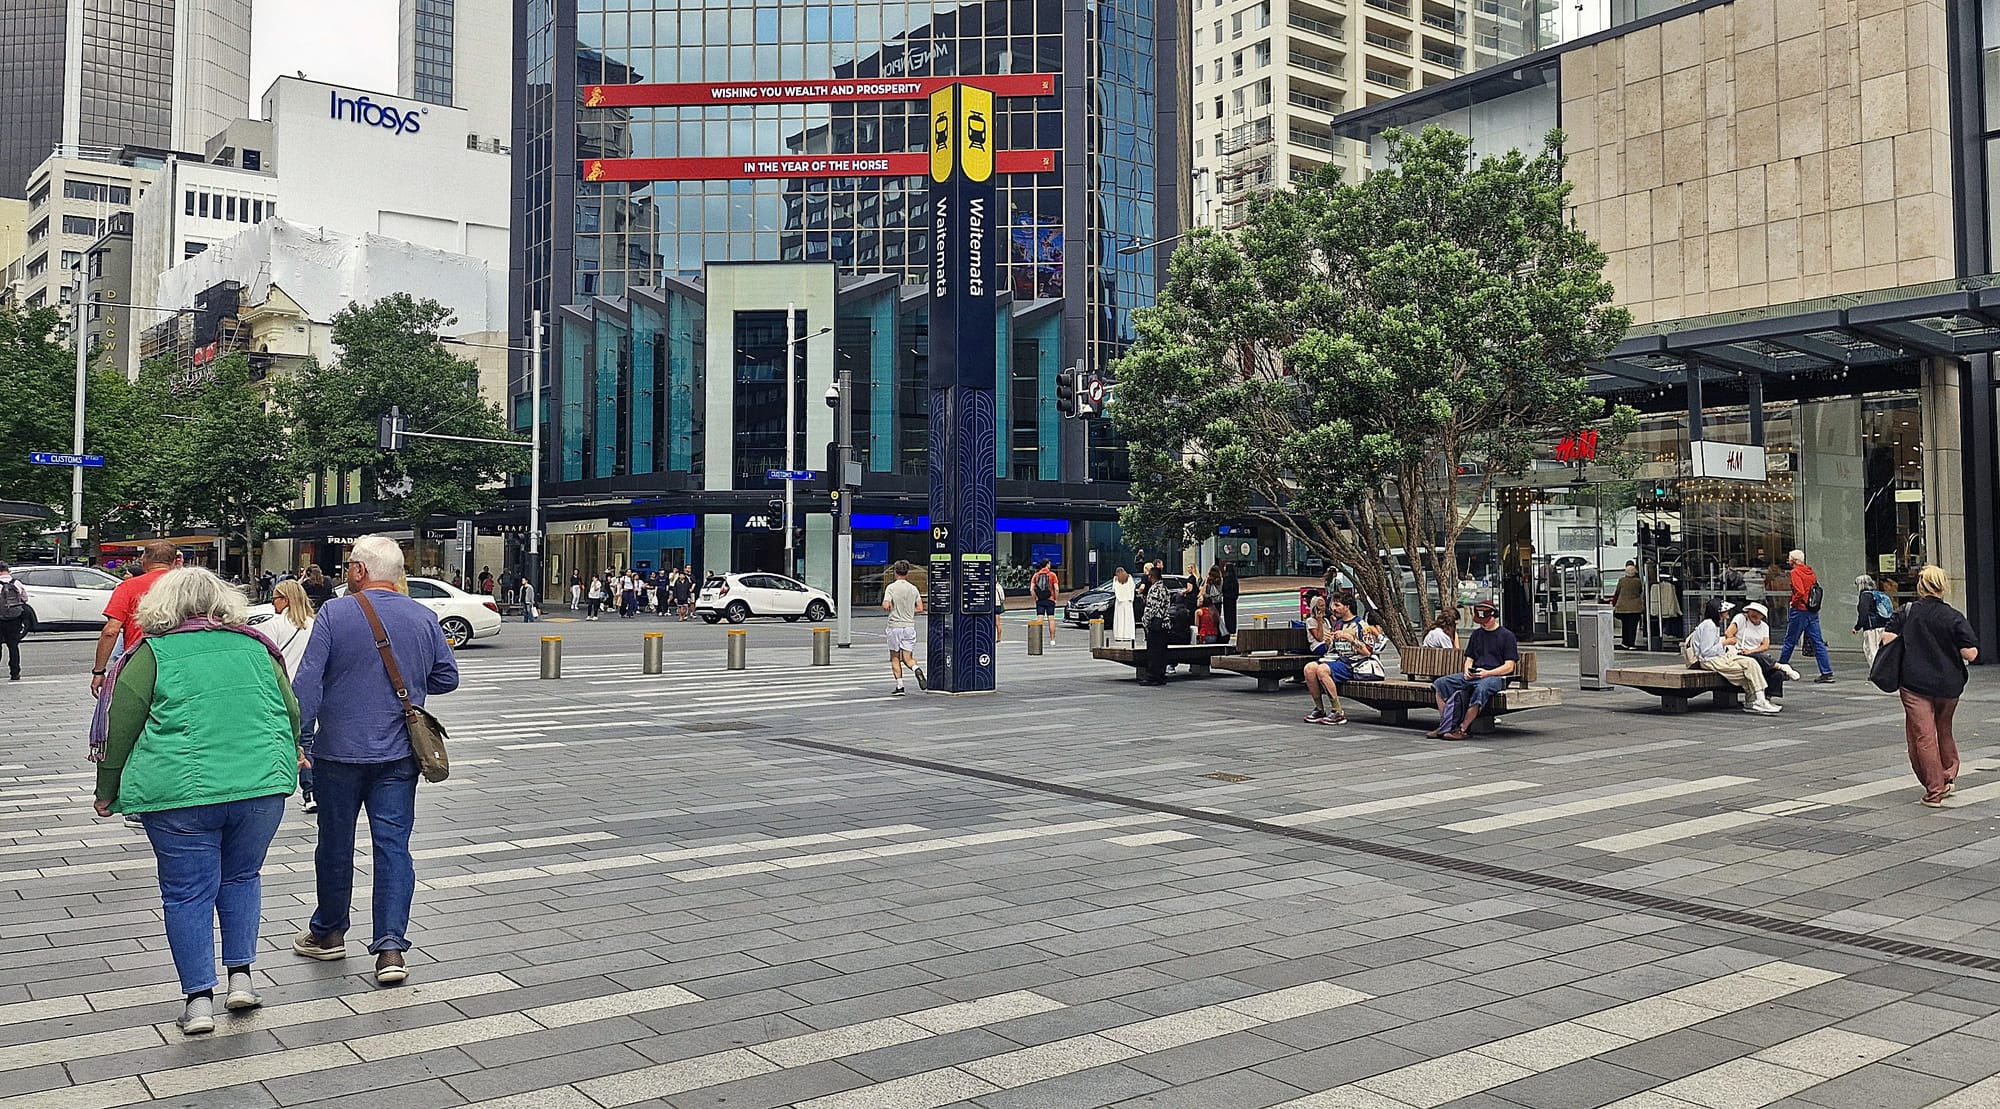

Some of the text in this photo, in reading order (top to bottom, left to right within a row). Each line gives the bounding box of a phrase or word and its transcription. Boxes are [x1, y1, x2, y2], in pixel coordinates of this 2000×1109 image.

[711, 83, 921, 98] WISHING YOU WEALTH AND PROSPERITY
[330, 90, 420, 135] Infosys
[744, 159, 888, 173] IN THE YEAR OF THE HORSE
[936, 197, 947, 297] Waitematā
[969, 198, 984, 296] Waitematā
[50, 455, 83, 464] CUSTOMS
[1726, 450, 1743, 472] H&M
[745, 515, 771, 528] AN
[427, 530, 444, 539] Dior
